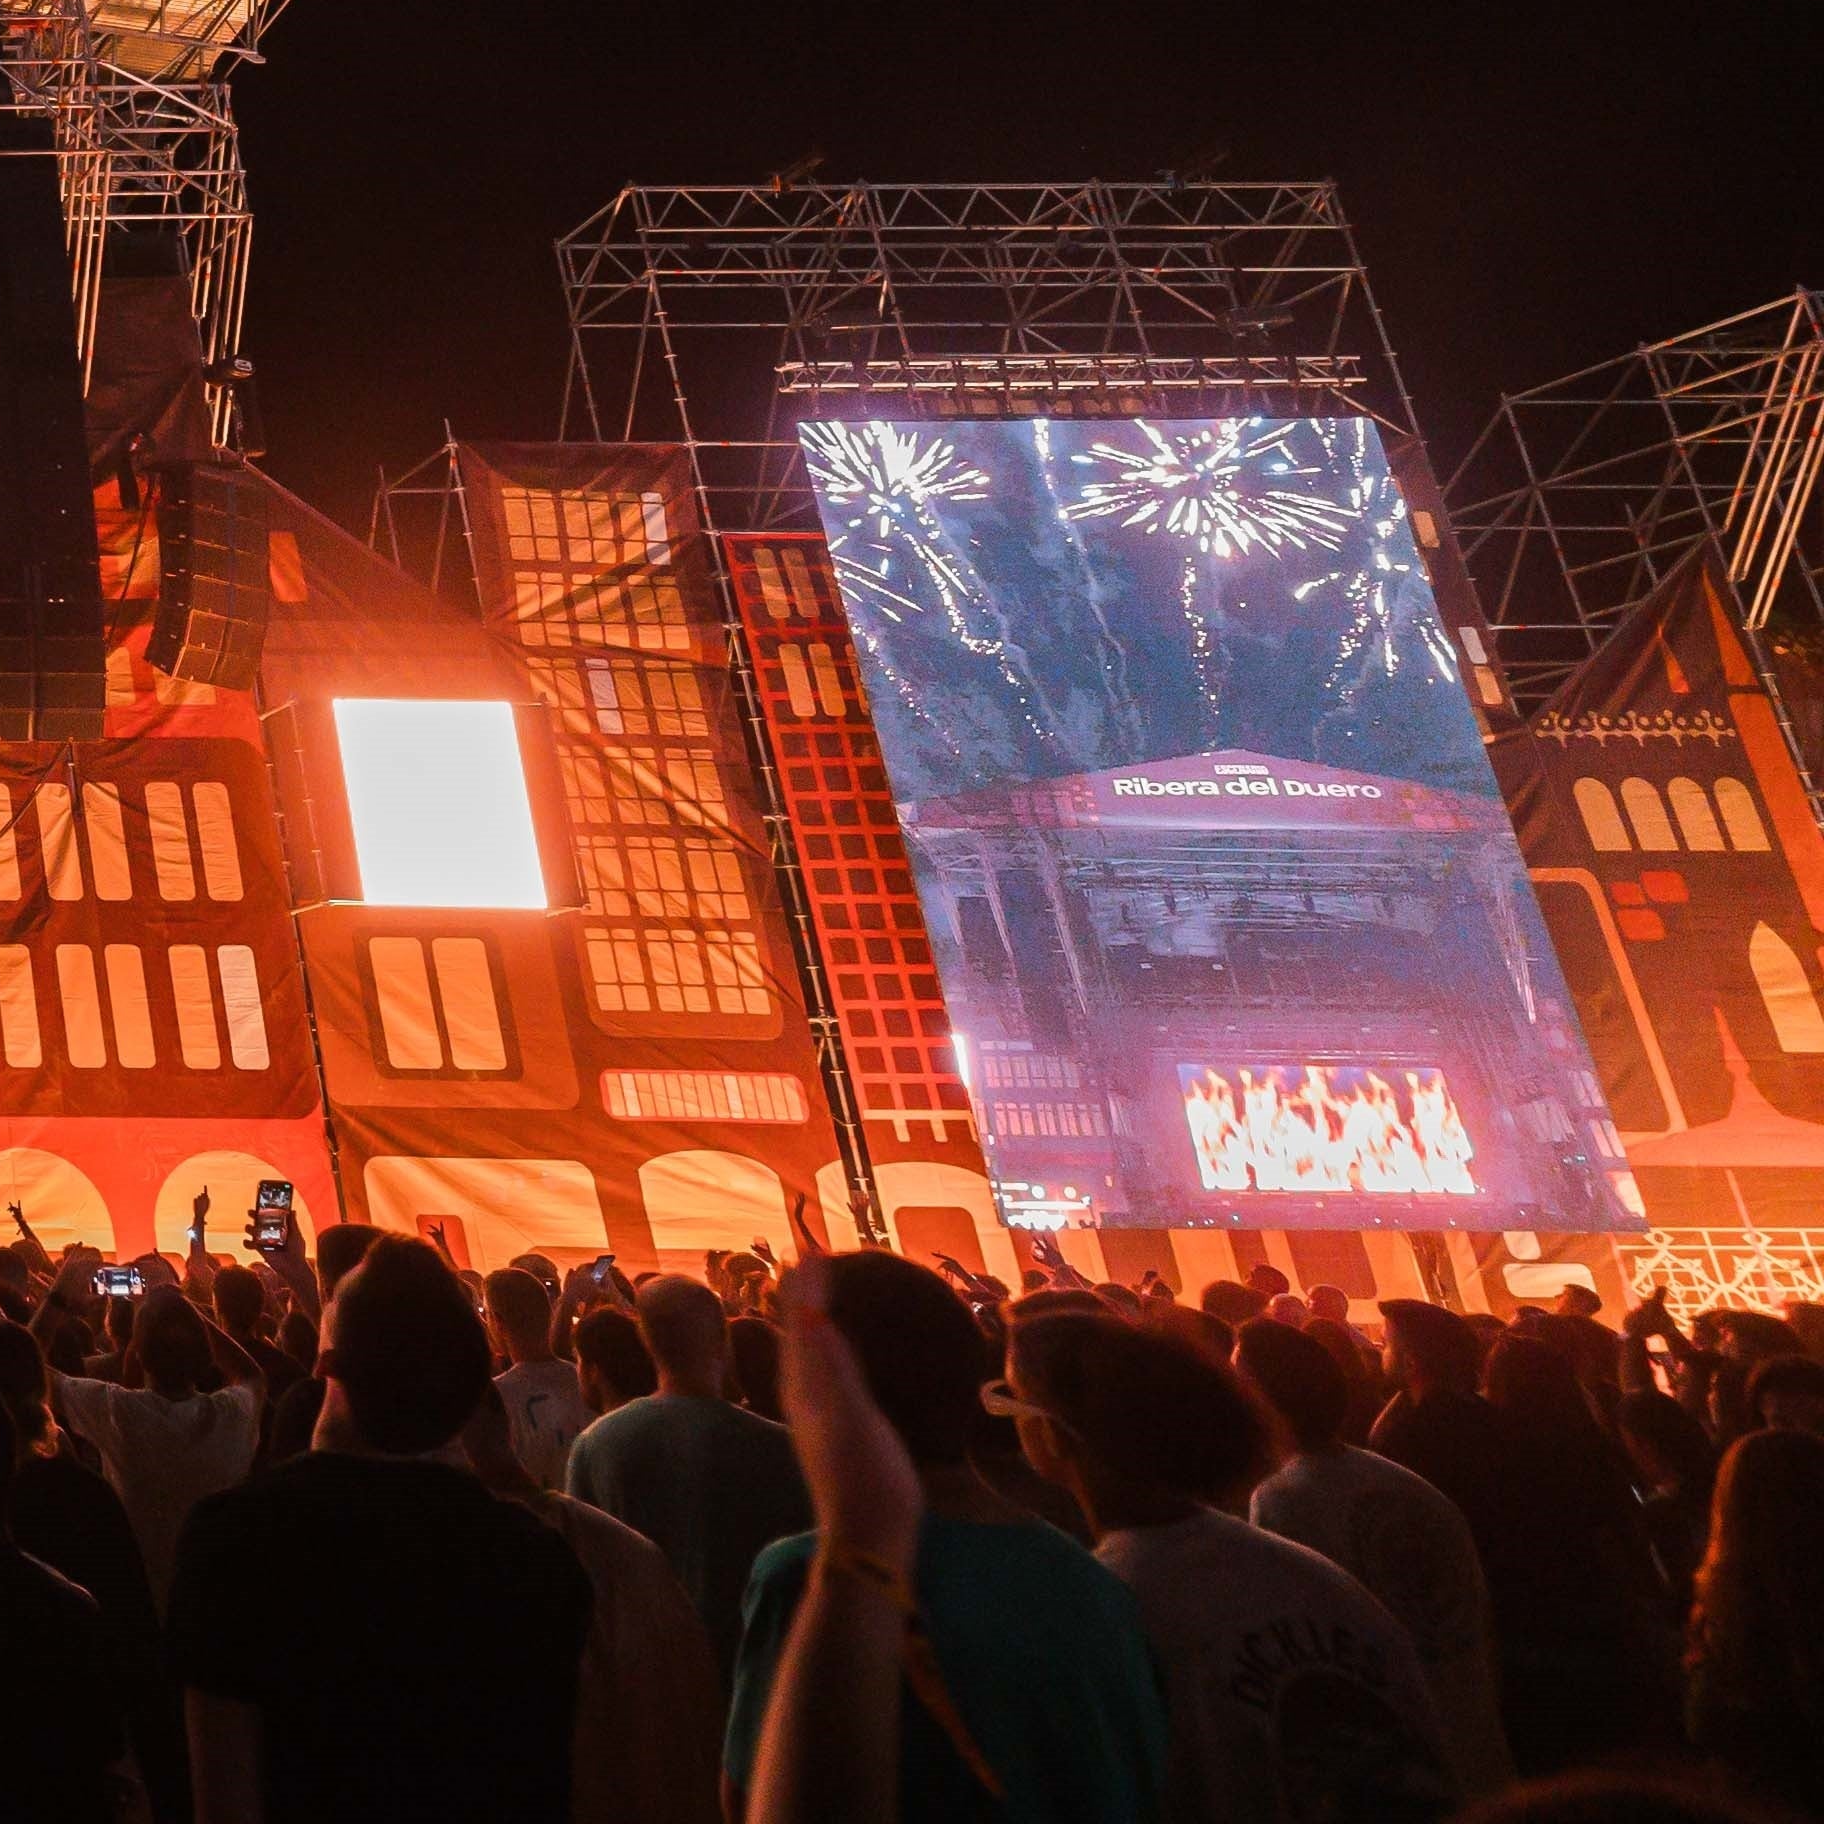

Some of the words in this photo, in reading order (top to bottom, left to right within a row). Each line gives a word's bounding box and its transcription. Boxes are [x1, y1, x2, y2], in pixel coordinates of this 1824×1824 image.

[1112, 778, 1220, 796] Ribera
[1224, 777, 1280, 796] del
[1282, 779, 1382, 799] Duero
